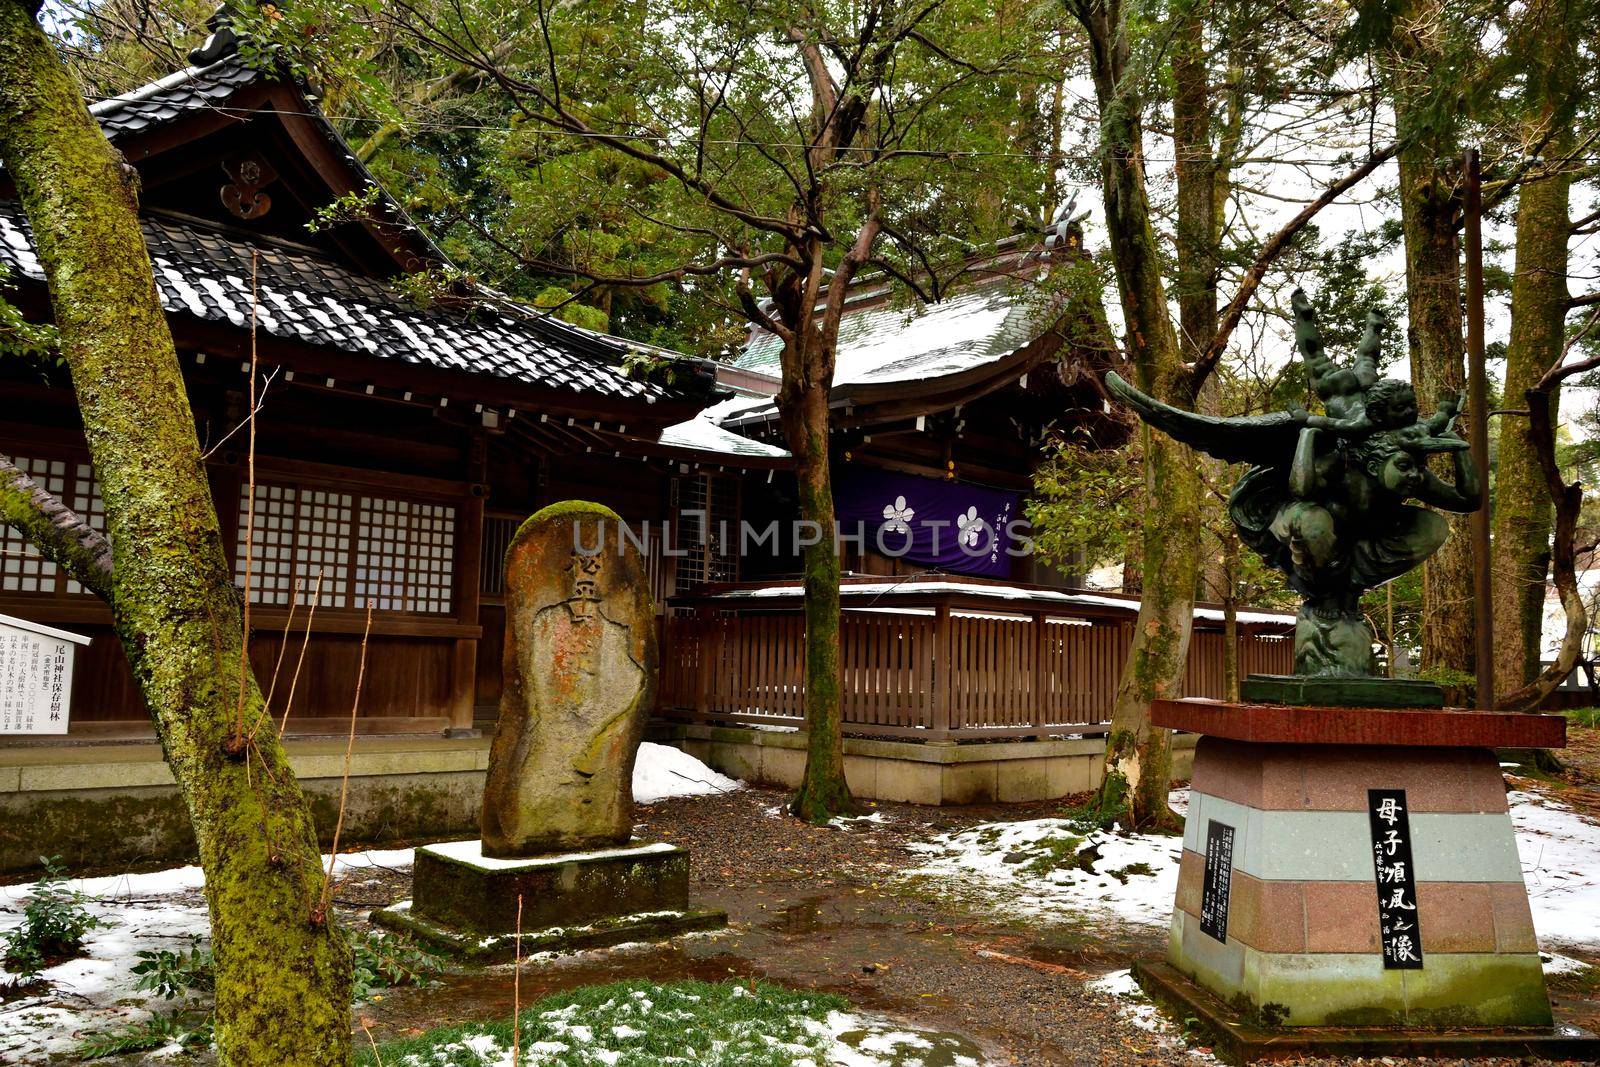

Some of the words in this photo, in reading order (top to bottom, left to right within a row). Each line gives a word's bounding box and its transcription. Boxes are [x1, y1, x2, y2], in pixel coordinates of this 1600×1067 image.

[50, 645, 65, 721] 尾山神社保存樹林
[1376, 798, 1420, 962] 母子順風之像
